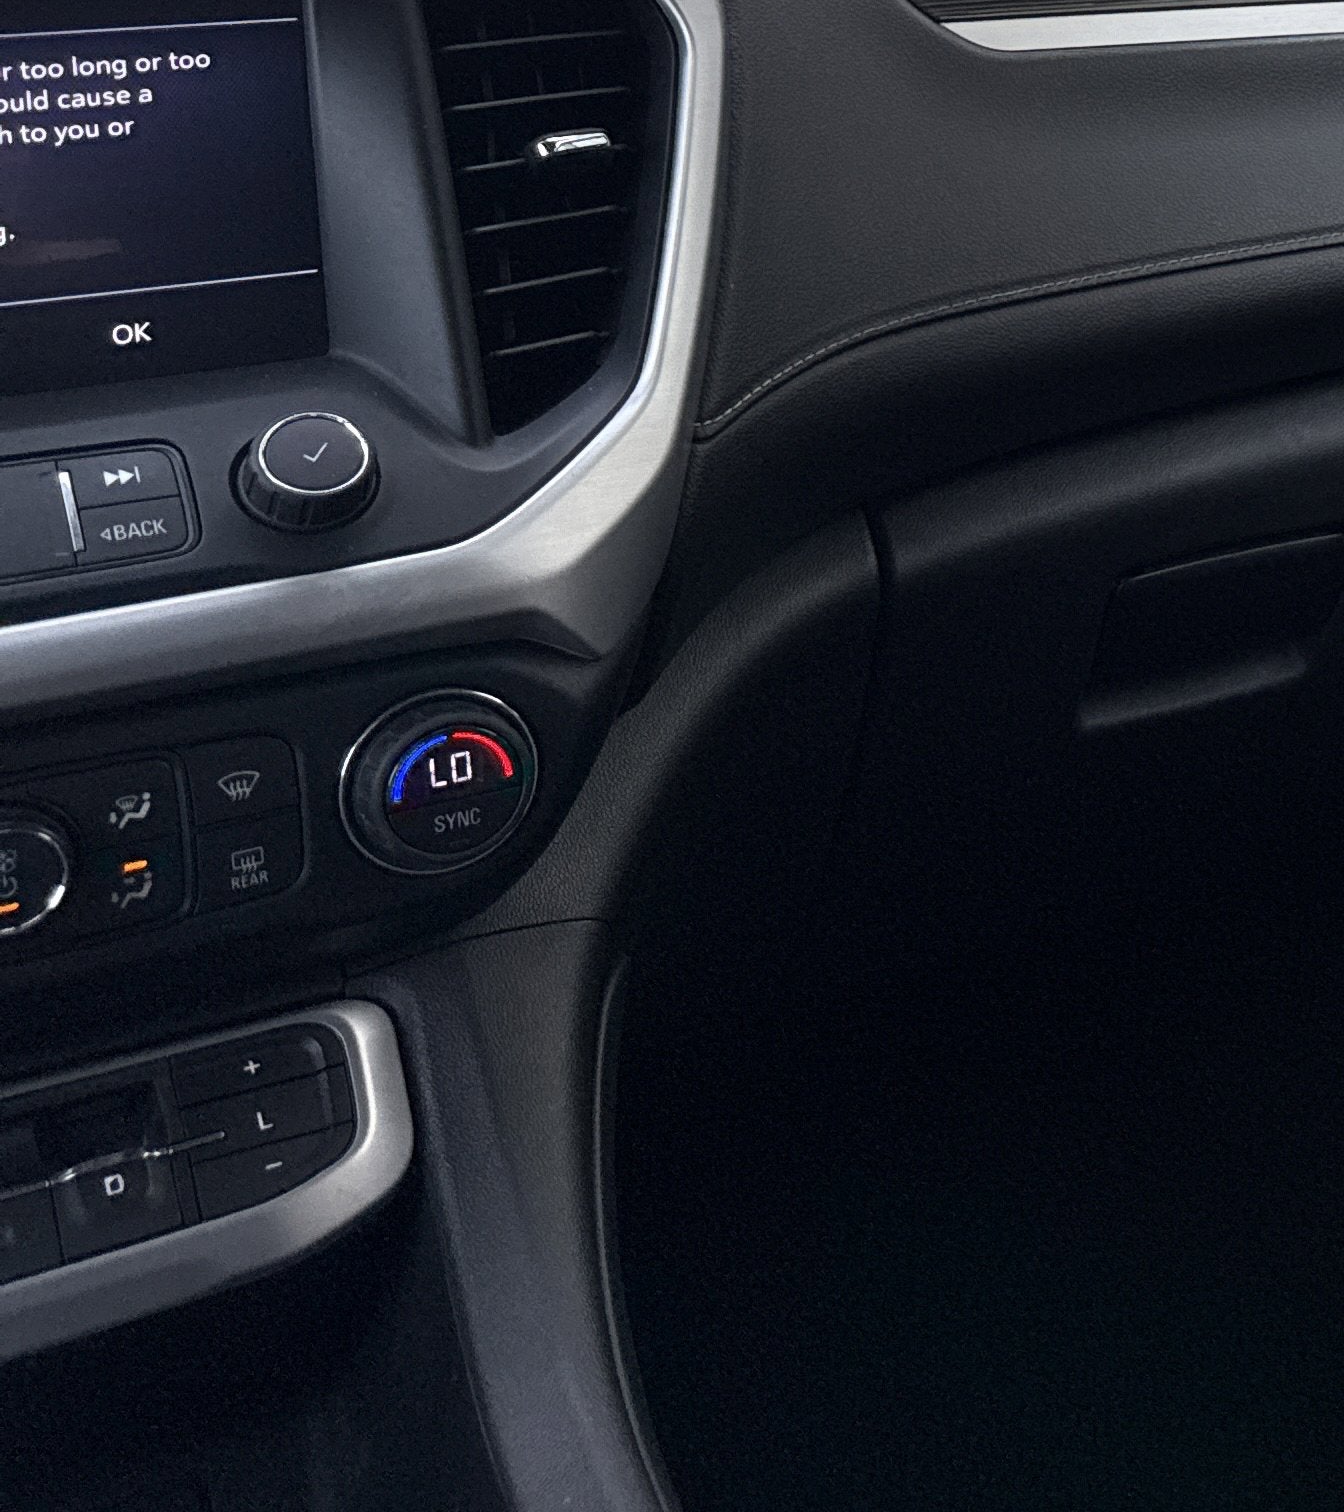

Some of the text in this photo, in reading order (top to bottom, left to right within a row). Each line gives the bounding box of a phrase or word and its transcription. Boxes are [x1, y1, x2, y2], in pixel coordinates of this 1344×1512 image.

[20, 61, 64, 80] too
[71, 55, 127, 80] long
[135, 56, 162, 72] or
[168, 52, 211, 70] too
[0, 88, 153, 113] ould cause a
[19, 125, 47, 144] to
[54, 123, 100, 147] you
[108, 120, 135, 137] or
[112, 322, 152, 345] OK
[113, 518, 167, 542] BACK
[433, 807, 481, 834] SYNC
[230, 868, 270, 889] REAR
[256, 1111, 273, 1130] L
[104, 1174, 125, 1196] D
